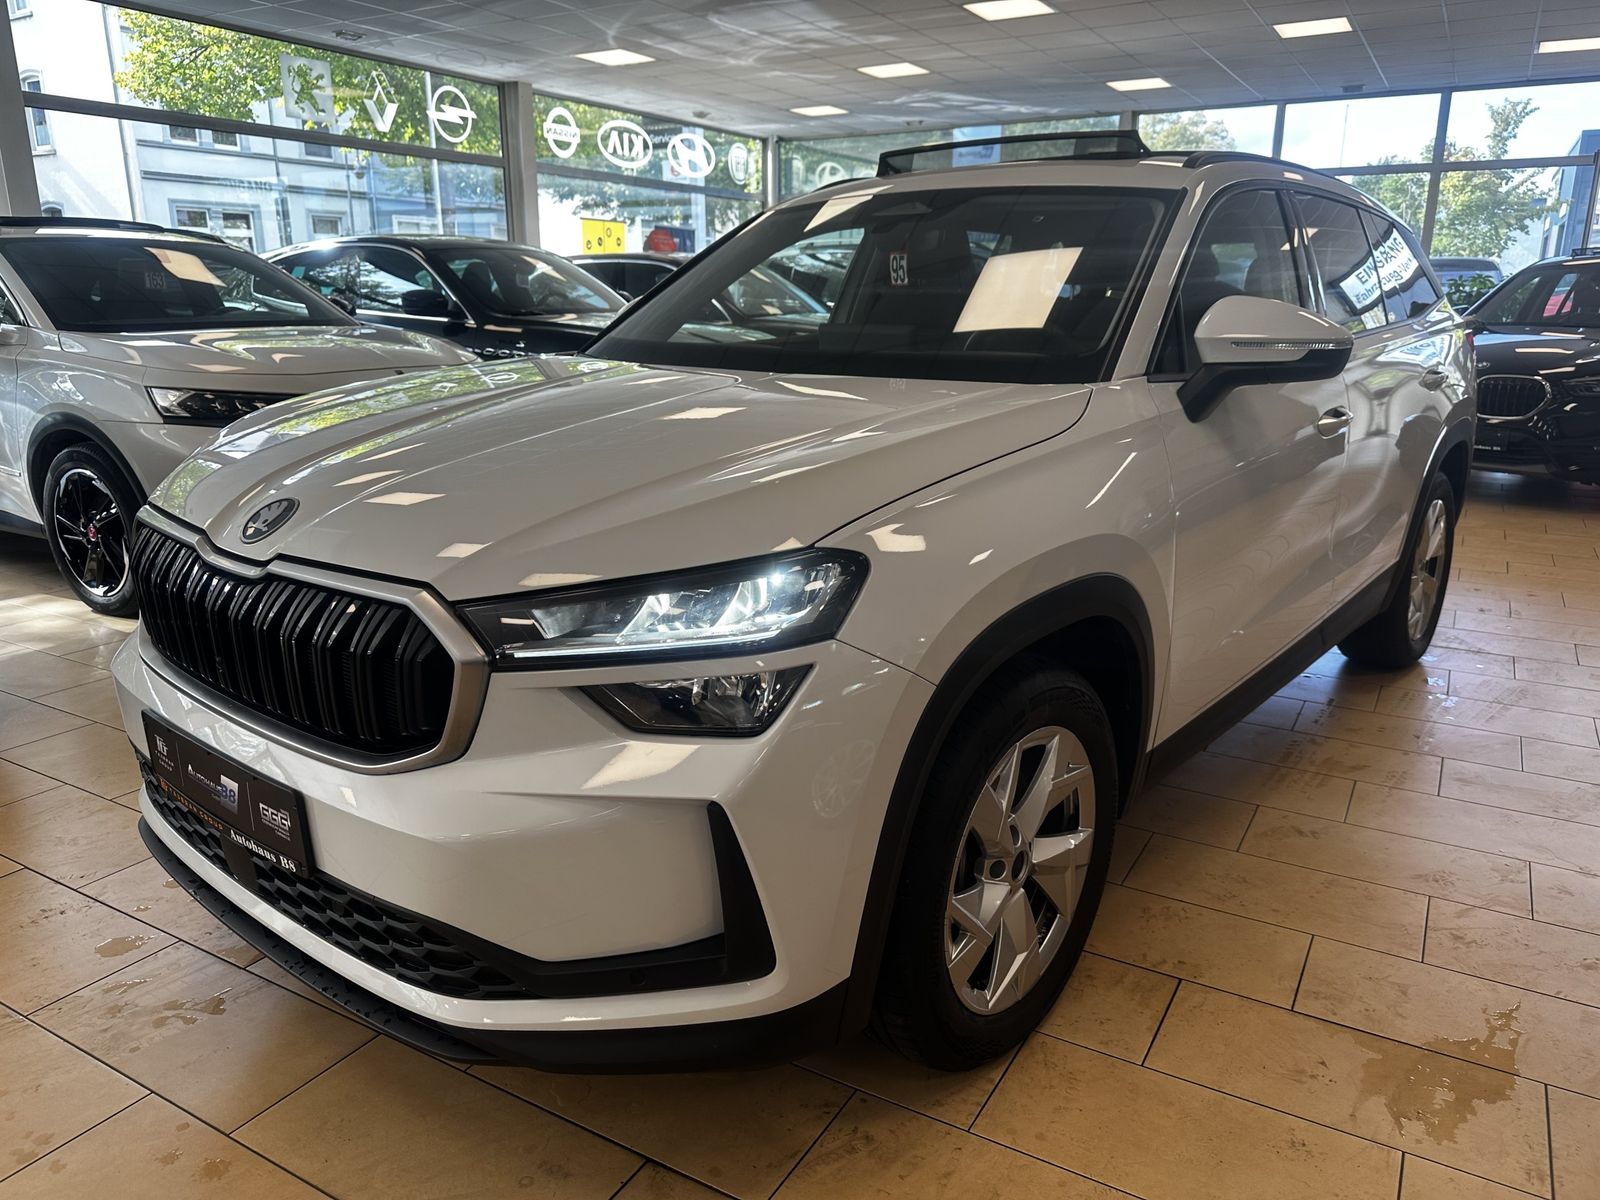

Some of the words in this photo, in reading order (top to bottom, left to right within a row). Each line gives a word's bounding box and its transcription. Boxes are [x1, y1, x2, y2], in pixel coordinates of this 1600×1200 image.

[649, 132, 672, 144] Servic
[891, 255, 906, 283] 95
[147, 272, 165, 289] 163
[230, 829, 277, 863] Autohaus
[279, 854, 296, 873] B8
